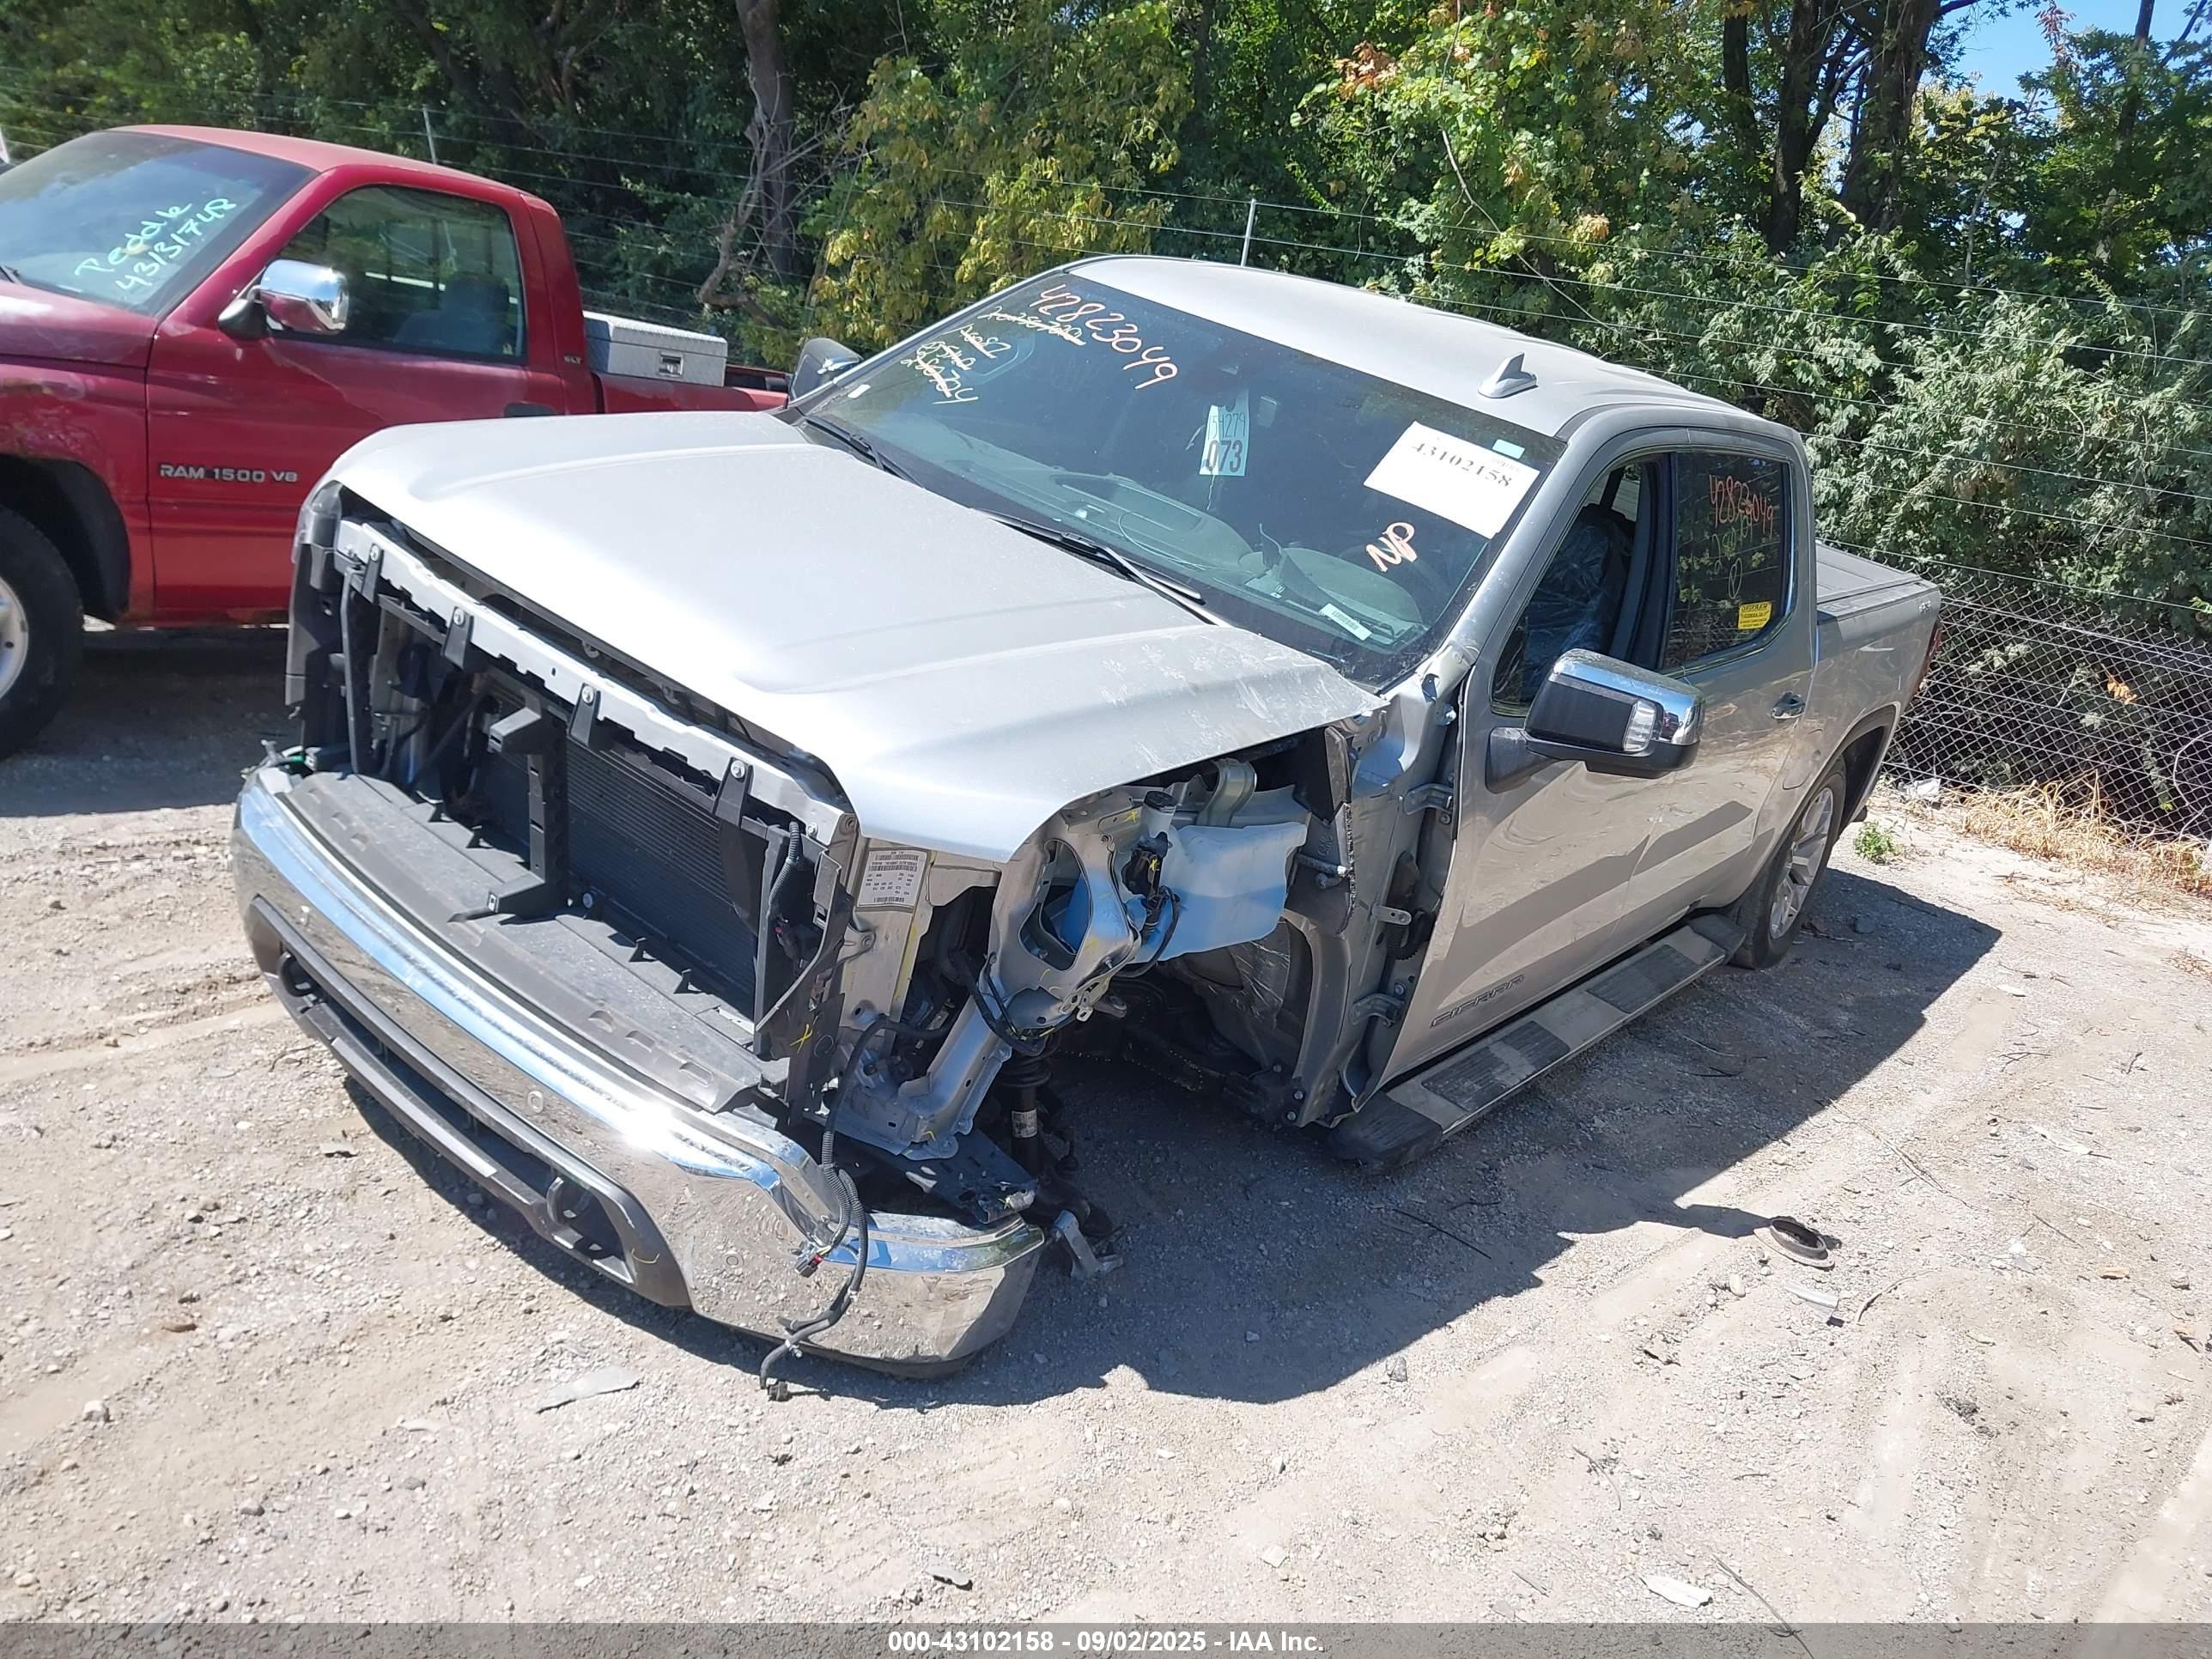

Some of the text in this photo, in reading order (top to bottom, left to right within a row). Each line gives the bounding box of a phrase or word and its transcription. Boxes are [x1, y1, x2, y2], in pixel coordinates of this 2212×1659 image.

[1029, 283, 1178, 390] 42823049
[160, 465, 298, 483] RAM 1500 V8
[1206, 439, 1243, 473] 073
[1412, 442, 1513, 487] 43102158
[1365, 522, 1418, 573] NP
[1430, 974, 1525, 1028] SIERRA
